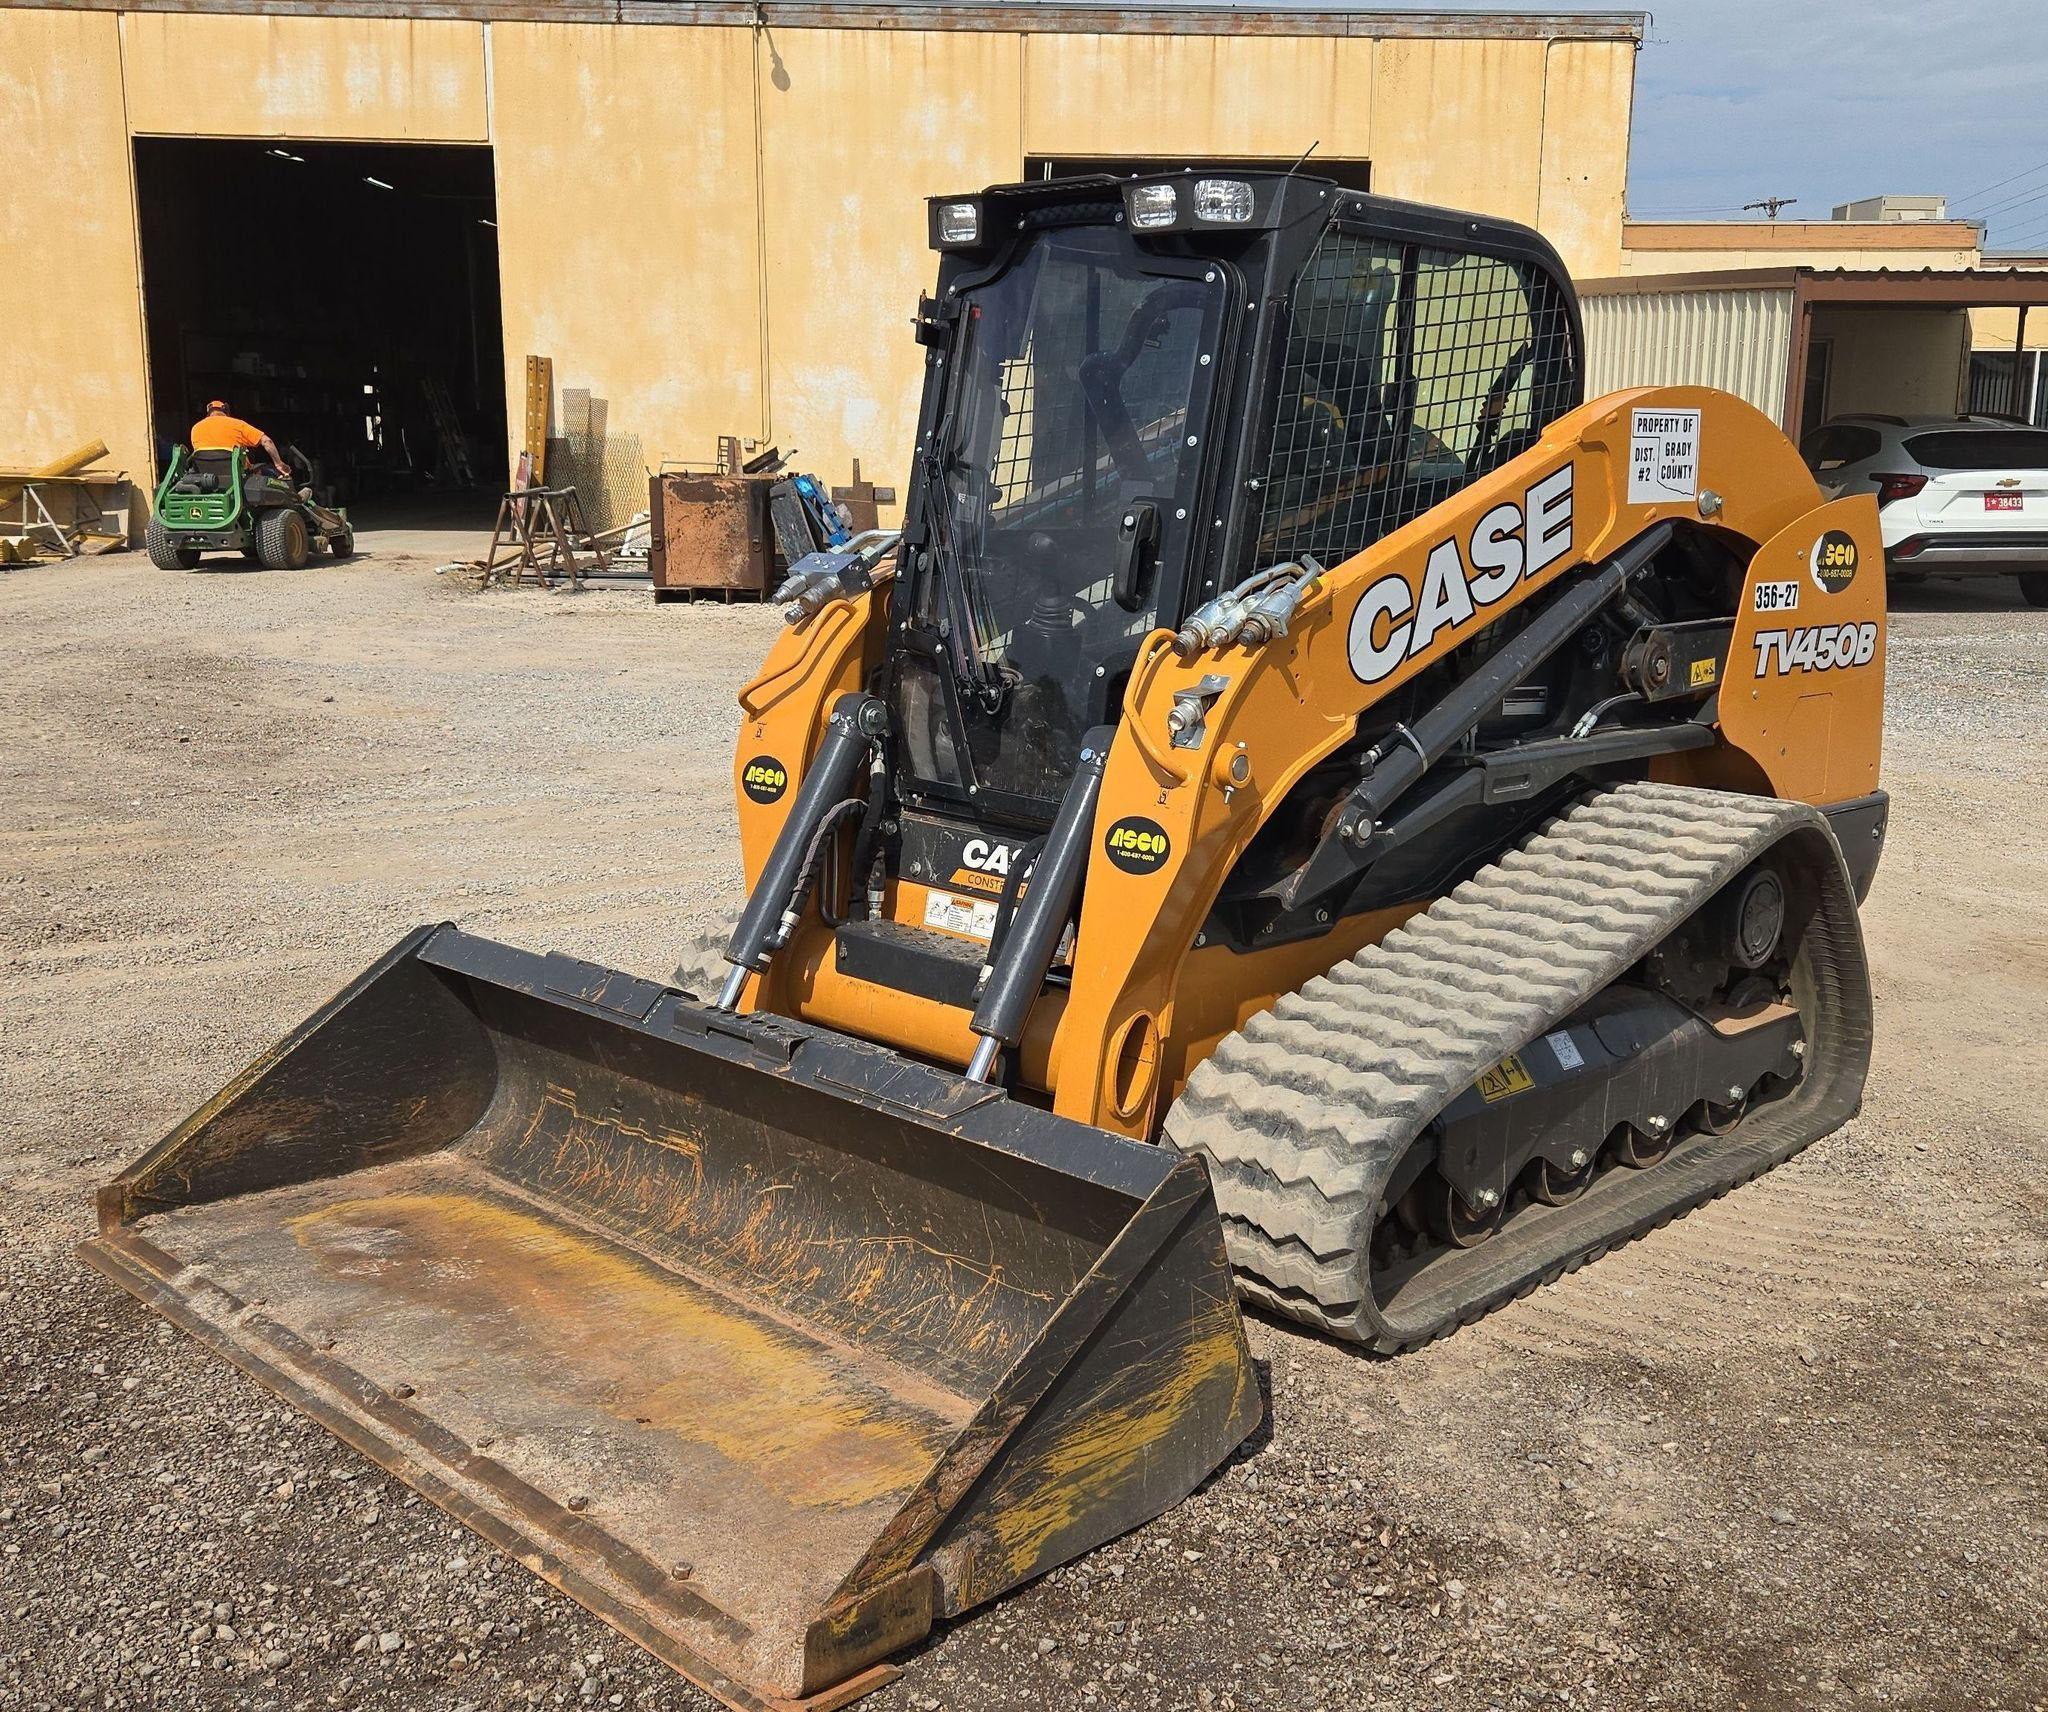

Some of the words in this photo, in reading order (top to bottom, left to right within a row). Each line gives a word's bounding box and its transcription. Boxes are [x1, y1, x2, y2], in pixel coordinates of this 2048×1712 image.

[1637, 417, 1680, 433] PROPERTY
[1682, 418, 1693, 433] OF
[1635, 447, 1656, 462] DIST.
[1665, 442, 1692, 457] GRADY
[1638, 467, 1651, 481] #2
[1661, 465, 1693, 480] COUNTY
[1998, 497, 2022, 507] 38433
[1816, 543, 1855, 566] SCO
[1347, 459, 1574, 684] CASE
[1755, 583, 1798, 609] 356-27
[1753, 621, 1879, 680] TV450B
[745, 765, 786, 787] ASCO
[1109, 827, 1167, 855] ASCO
[962, 838, 1041, 879] CA
